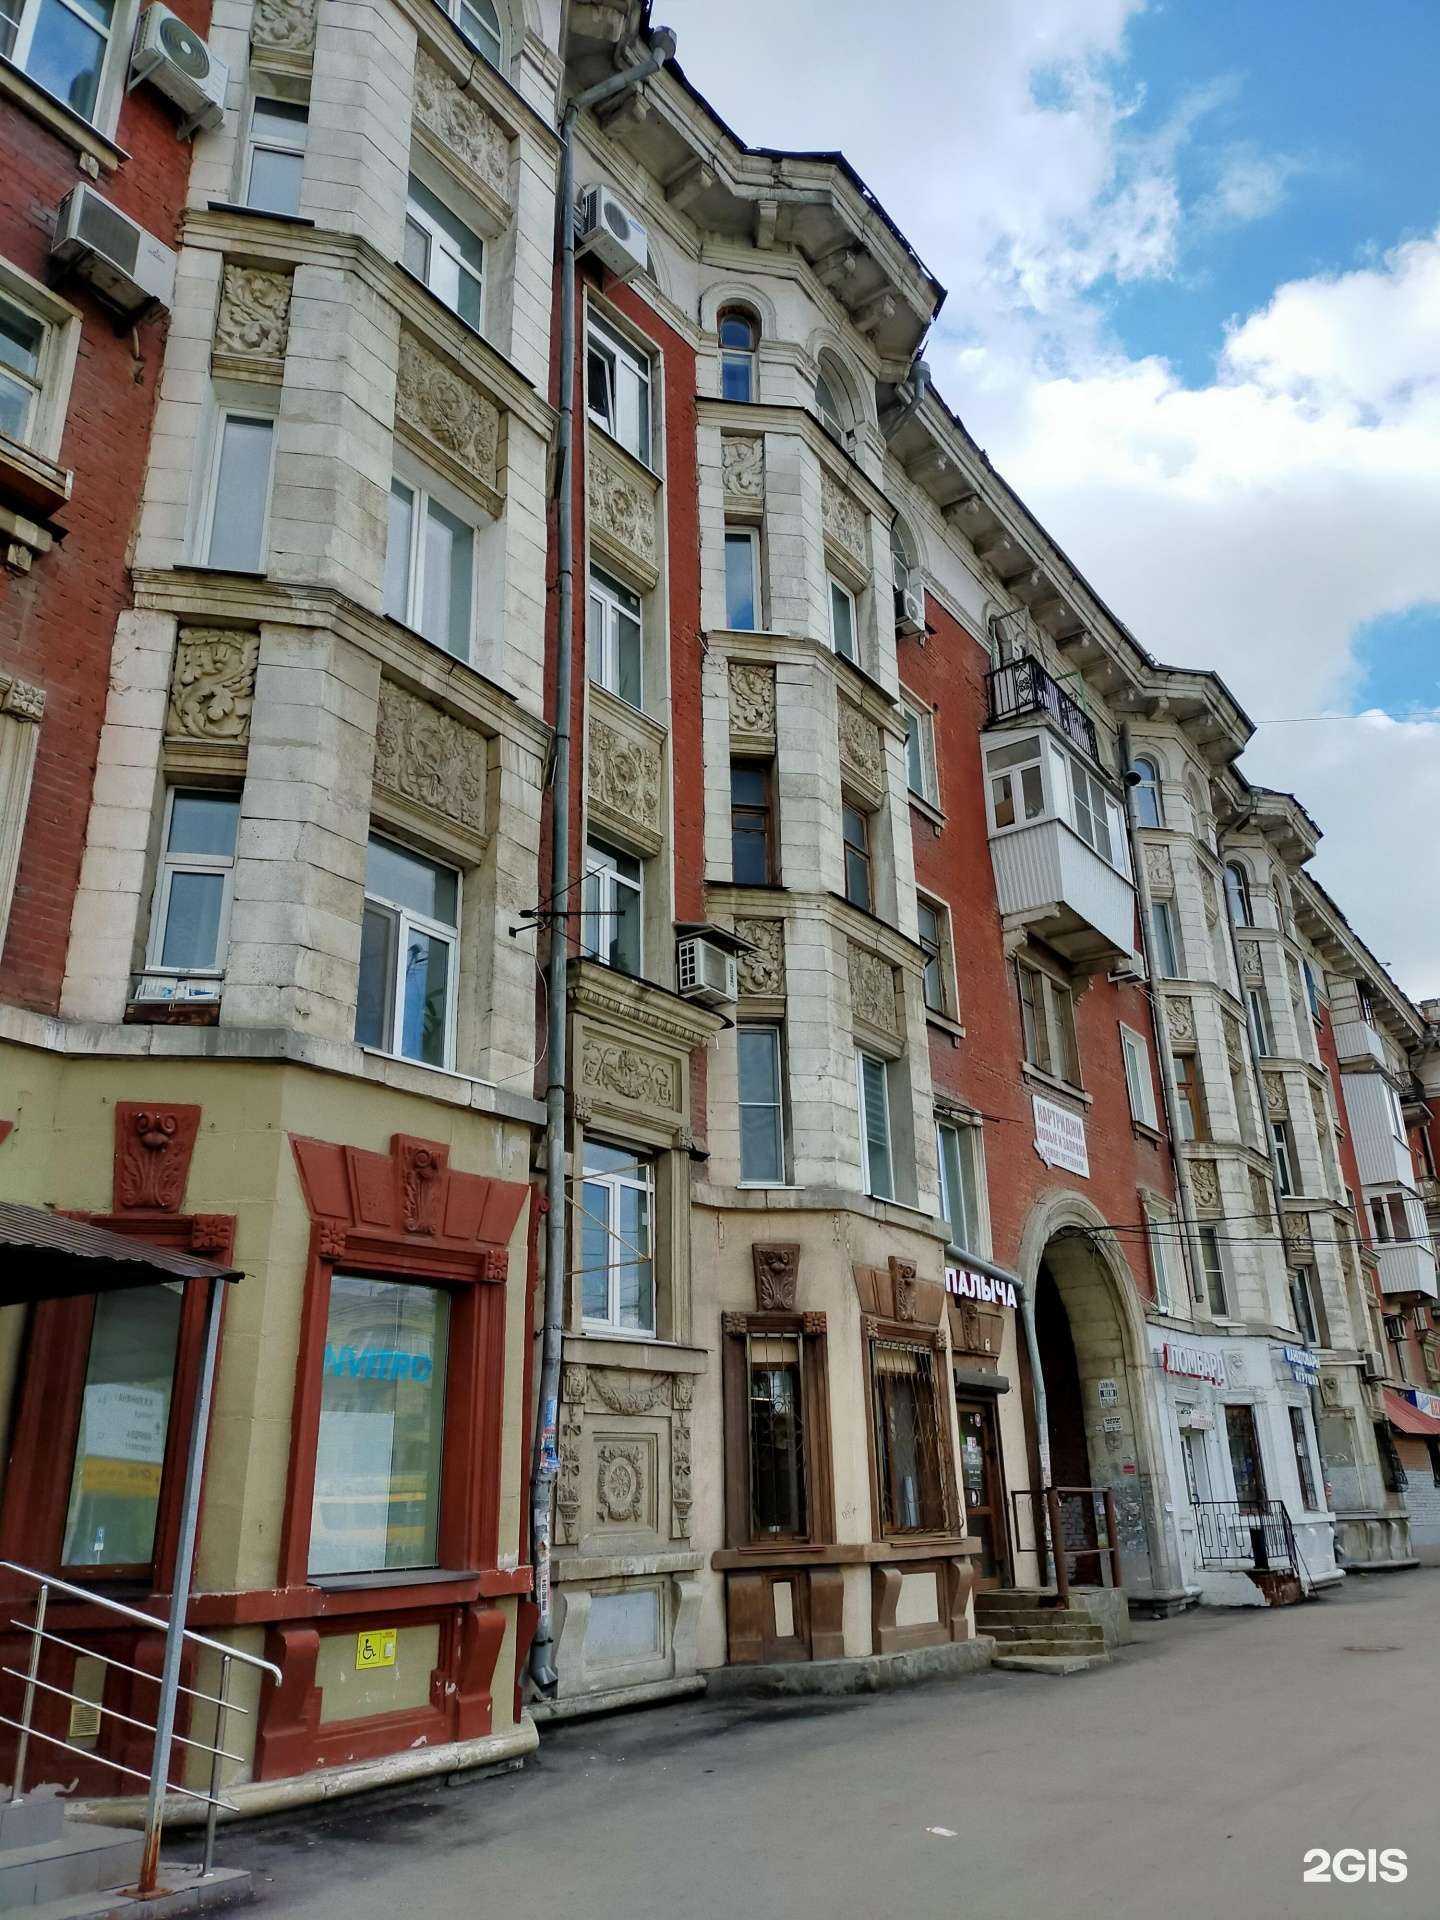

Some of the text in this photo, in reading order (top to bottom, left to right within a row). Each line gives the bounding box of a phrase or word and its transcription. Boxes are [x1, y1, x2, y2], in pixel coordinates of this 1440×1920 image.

[1037, 1104, 1083, 1141] КАРТРИДЖИ
[945, 1267, 1017, 1308] ПАЛЫЧА
[1164, 1343, 1225, 1386] ЛОМБАРД
